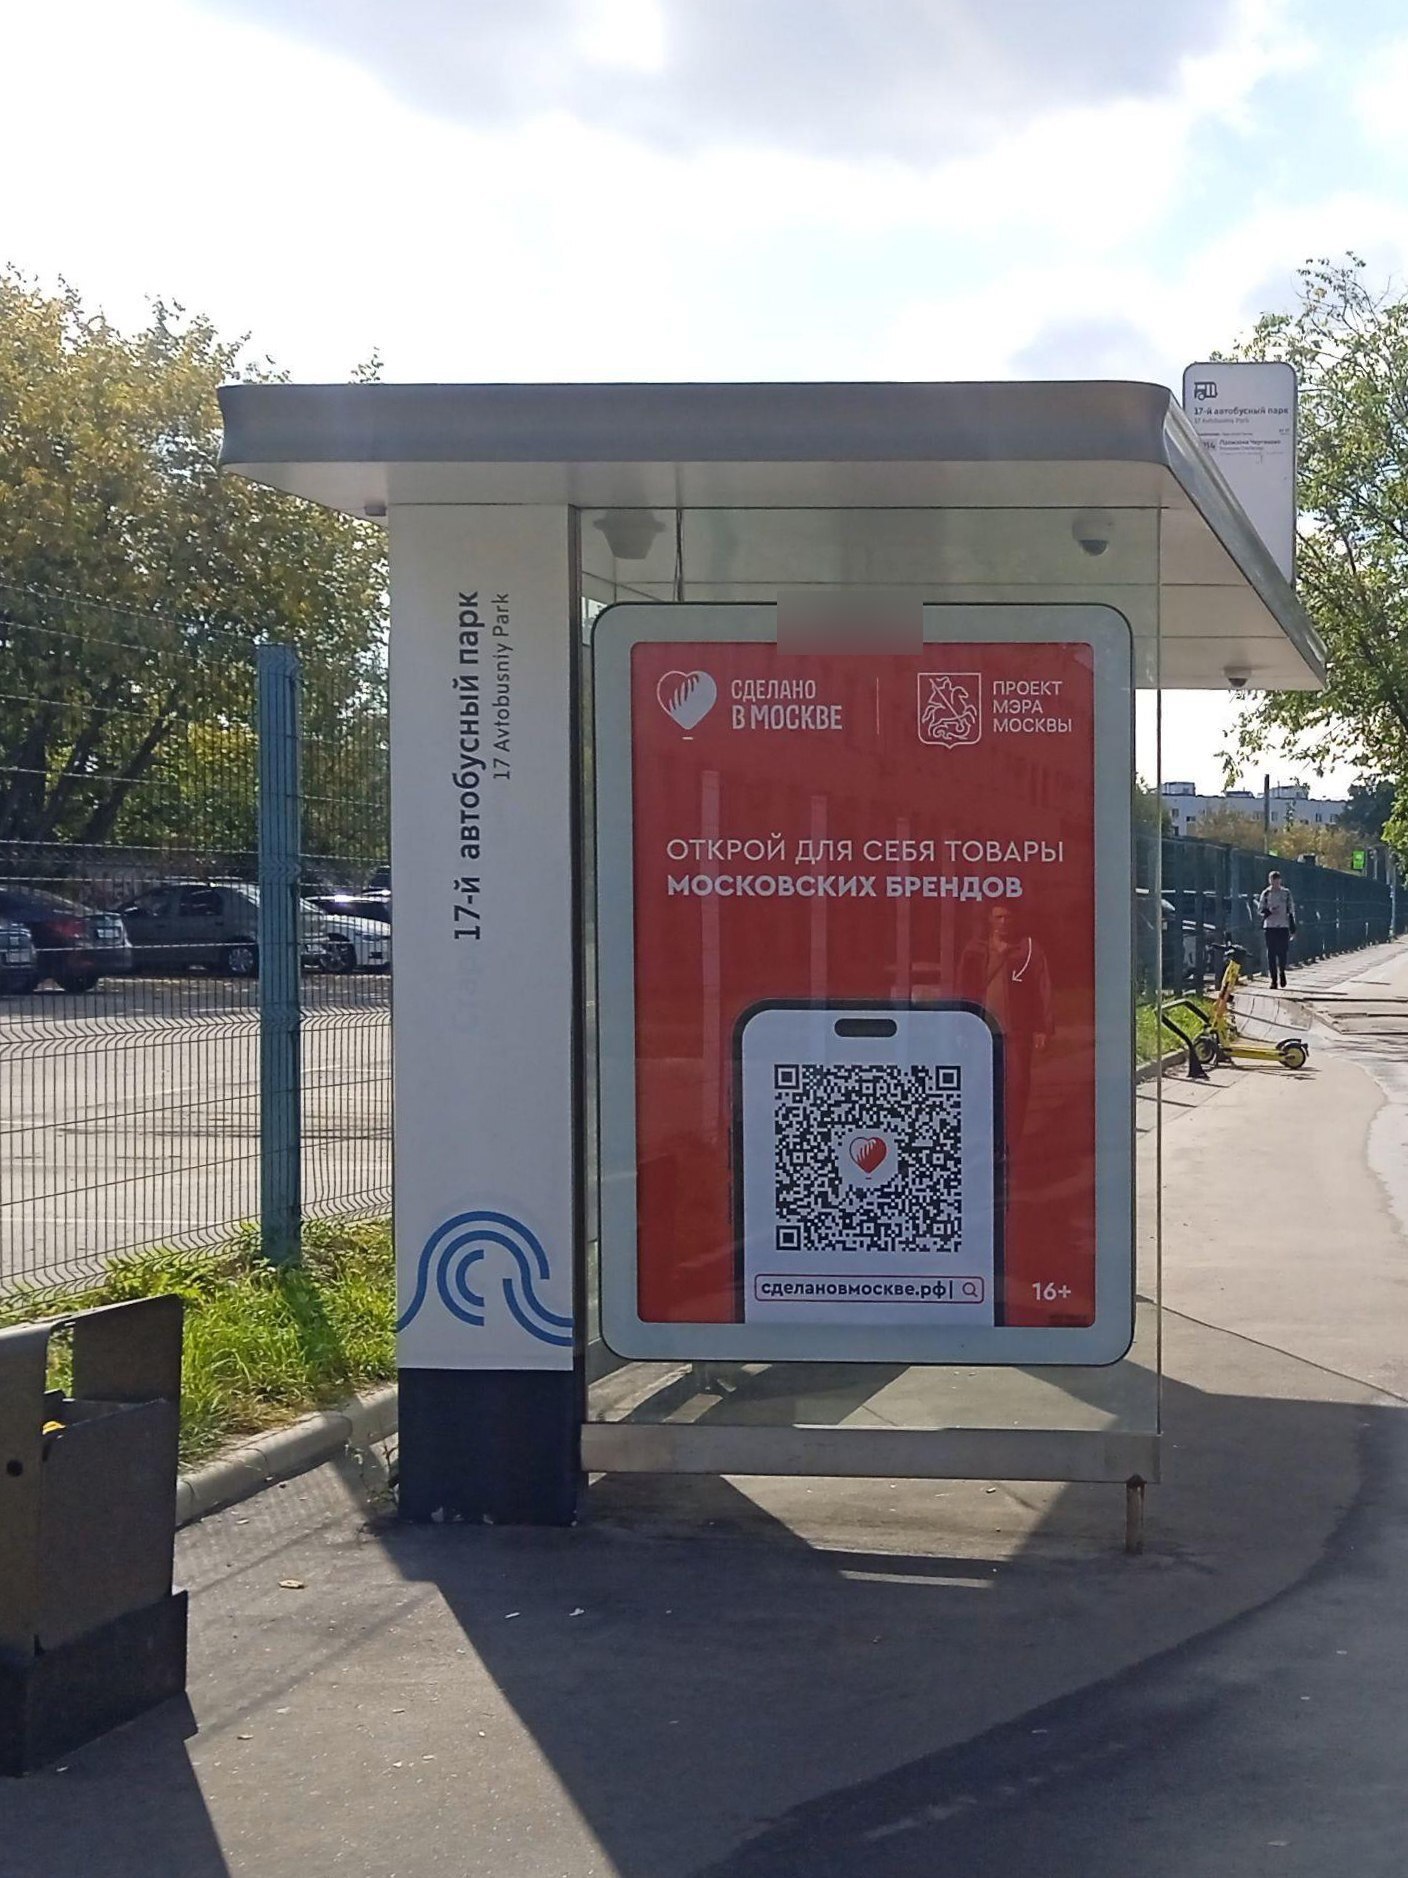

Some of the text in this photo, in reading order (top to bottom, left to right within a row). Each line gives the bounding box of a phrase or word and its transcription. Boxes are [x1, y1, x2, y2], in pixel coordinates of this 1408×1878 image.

[1194, 405, 1290, 417] 17-й автобусный парк
[458, 591, 485, 665] парк
[490, 593, 514, 780] 17 Avtobusniy Park
[731, 679, 816, 702] СДЕЛАНО
[993, 680, 1063, 695] ПРОЕКТ
[732, 704, 843, 731] В МОСКВЕ
[993, 699, 1044, 714] МЭРА
[993, 717, 1073, 733] МОСКВЫ
[452, 675, 486, 860] автобусный
[666, 832, 1064, 865] ОТКРОЙ ДЛЯ СЕБЯ ТОВАРЫ
[667, 874, 1024, 902] МОСКОВСКИХ БРЕНДОВ
[452, 876, 481, 940] 17-й
[760, 1279, 947, 1301] сделановмоскве.рф
[1031, 1281, 1072, 1301] 16+
